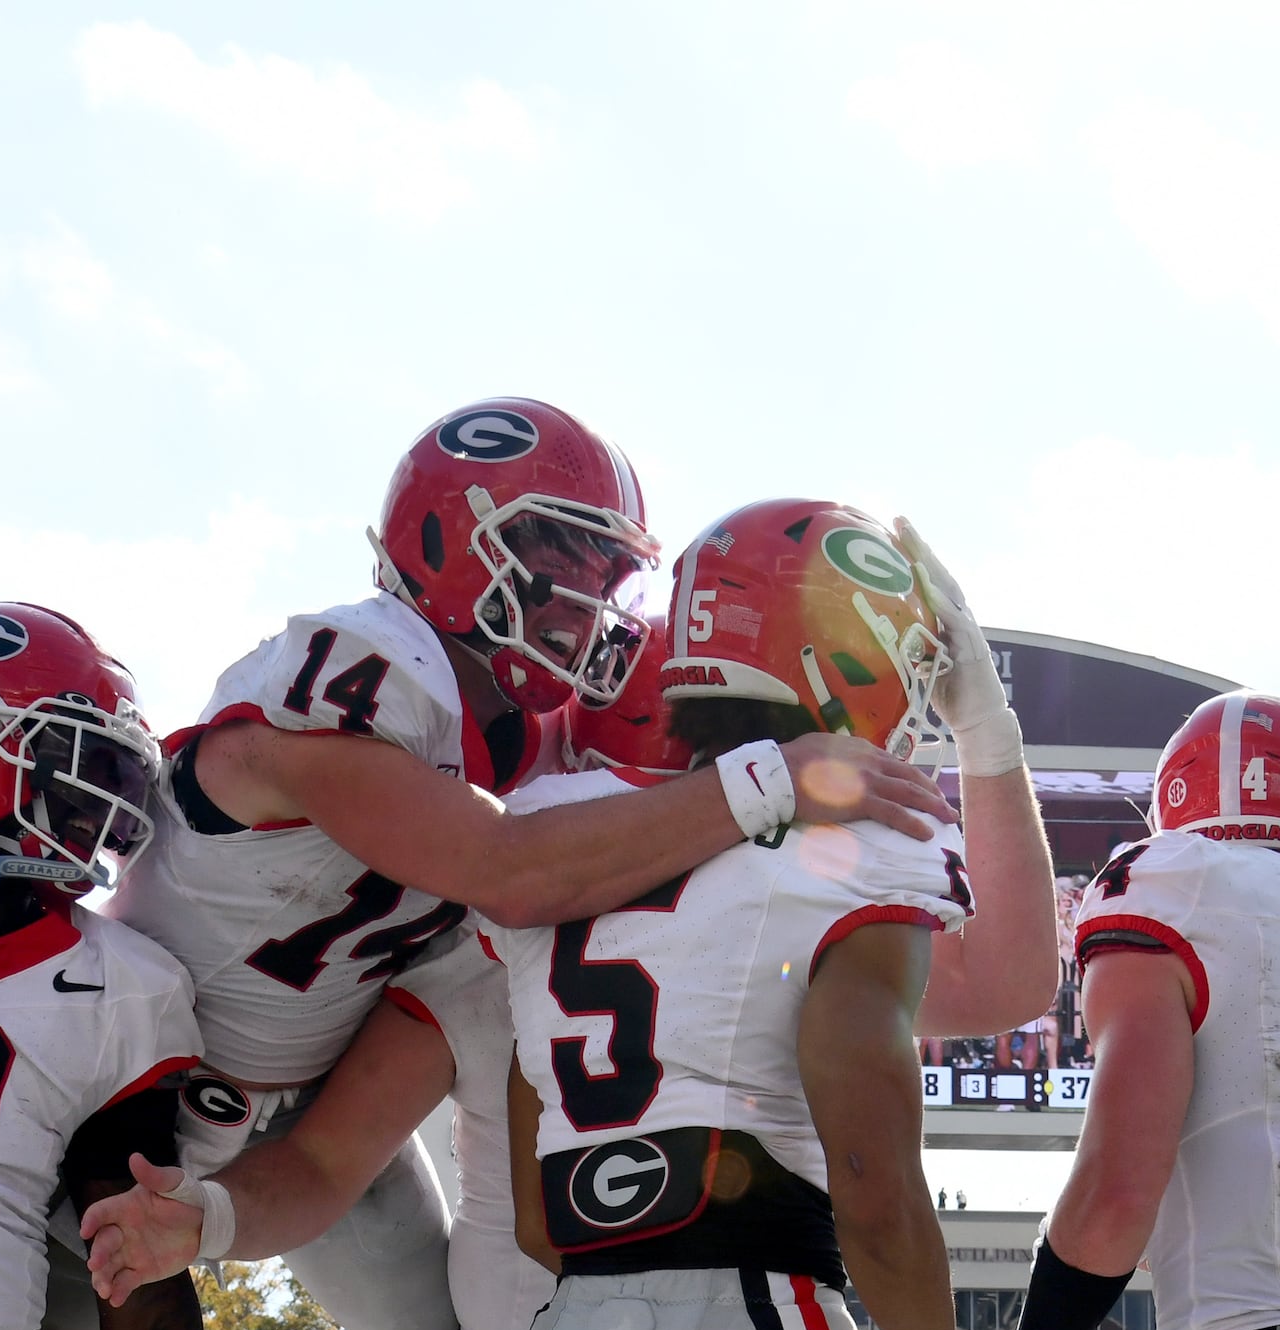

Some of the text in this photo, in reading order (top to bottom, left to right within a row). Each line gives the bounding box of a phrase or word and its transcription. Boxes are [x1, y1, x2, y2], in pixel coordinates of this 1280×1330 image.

[436, 409, 540, 463] G
[821, 526, 915, 598] G
[689, 590, 717, 642] 5
[282, 627, 391, 736] 14
[658, 665, 727, 693] ORGIA
[1242, 758, 1267, 800] 4
[549, 869, 694, 1132] 5
[181, 1075, 252, 1127] G
[925, 1074, 938, 1095] 8
[972, 1080, 980, 1093] 3
[1062, 1077, 1090, 1099] 37
[570, 1136, 669, 1229] G
